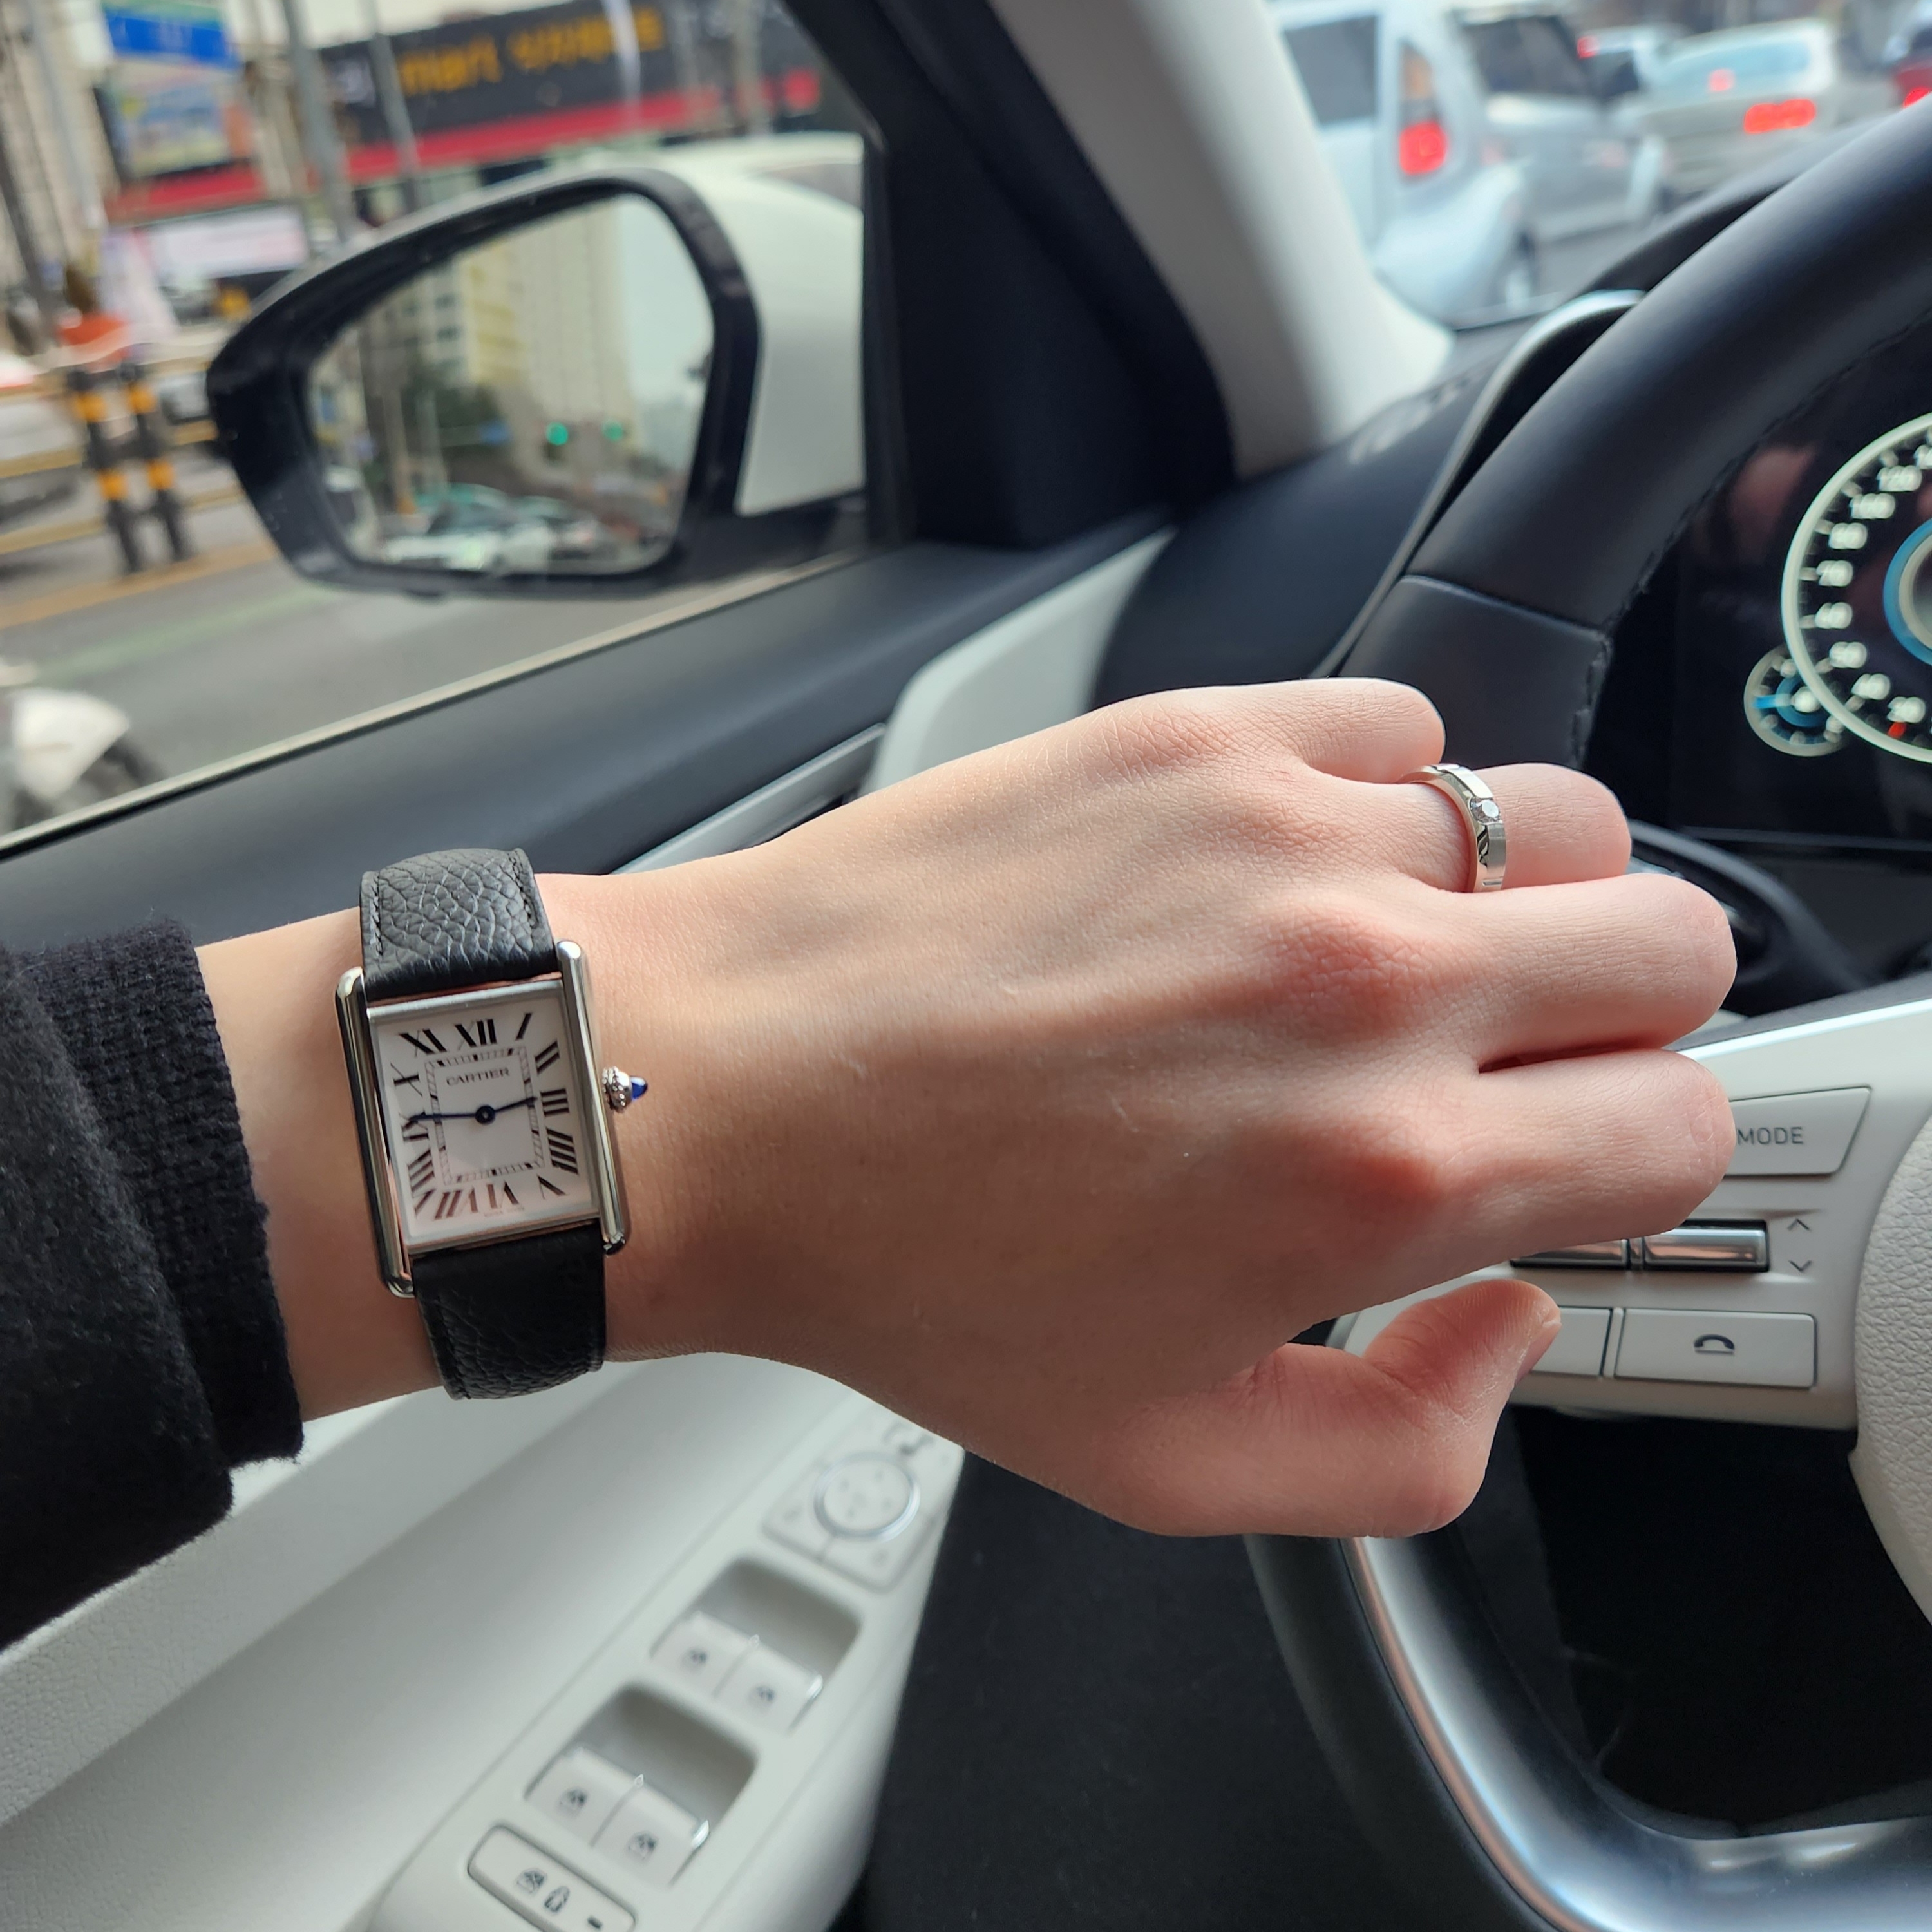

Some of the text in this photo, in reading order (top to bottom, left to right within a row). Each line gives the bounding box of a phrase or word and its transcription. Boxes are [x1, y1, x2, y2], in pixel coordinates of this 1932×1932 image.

[399, 1028, 447, 1058] XI
[454, 1019, 497, 1051] XII
[535, 1039, 560, 1075] II
[390, 1063, 423, 1097] X
[446, 1067, 510, 1086] CARTIER
[540, 1088, 569, 1117] III
[1736, 1126, 1804, 1145] MODE
